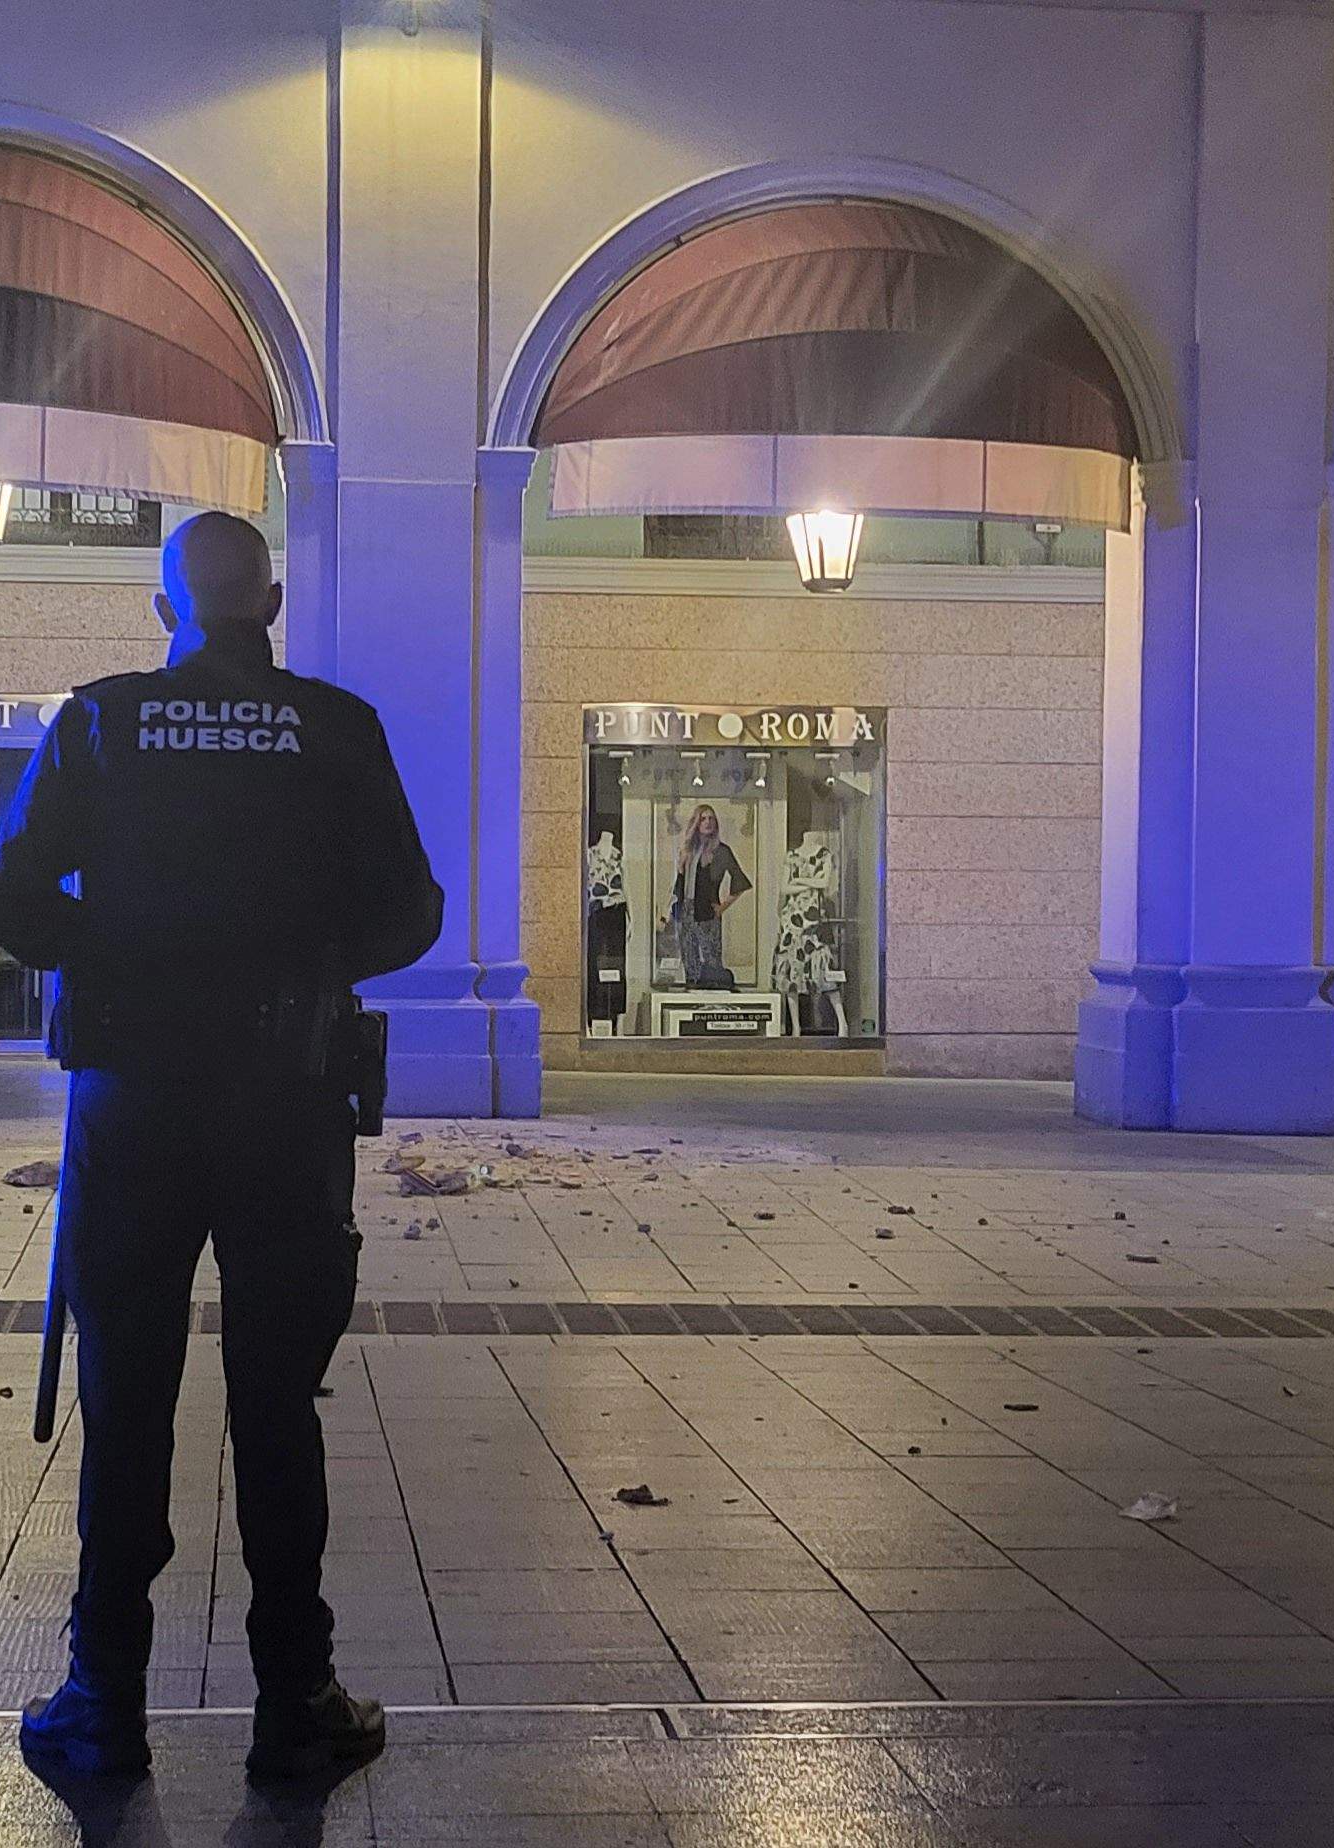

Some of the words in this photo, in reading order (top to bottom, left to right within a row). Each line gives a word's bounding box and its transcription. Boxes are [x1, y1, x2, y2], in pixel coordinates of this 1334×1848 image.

[139, 700, 301, 726] POLICIA
[595, 710, 700, 740] PUNT
[760, 712, 874, 742] ROMA
[138, 727, 302, 753] HUESCA
